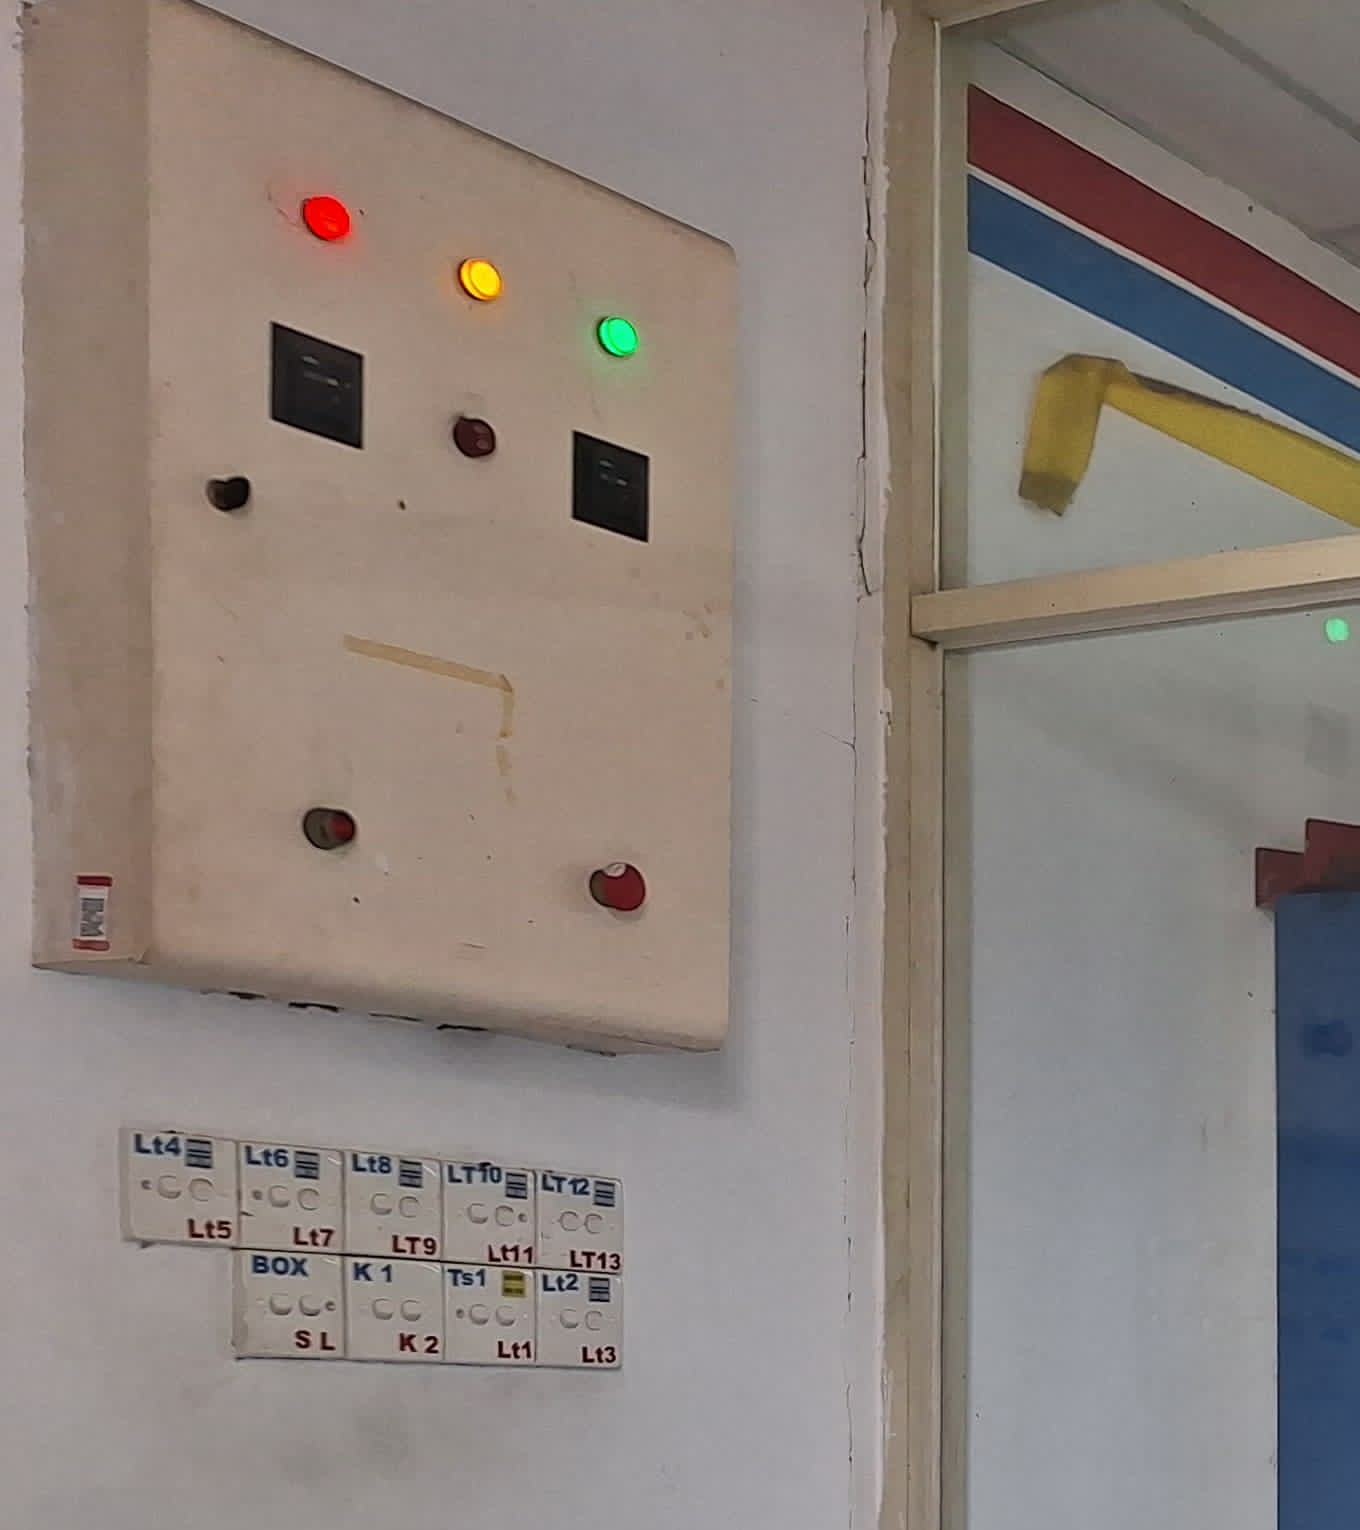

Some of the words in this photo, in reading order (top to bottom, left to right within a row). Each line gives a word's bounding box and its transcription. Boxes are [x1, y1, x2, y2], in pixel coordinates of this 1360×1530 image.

[134, 1133, 182, 1156] Lt4
[244, 1145, 290, 1168] Lt6
[351, 1153, 393, 1175] Lt8
[447, 1164, 503, 1184] LT10
[541, 1173, 591, 1196] LT12
[187, 1218, 232, 1240] Lt5
[293, 1227, 335, 1247] Lt7
[391, 1235, 437, 1256] LT9
[487, 1245, 534, 1264] Lt11
[251, 1255, 309, 1278] BOX
[569, 1250, 622, 1271] LT13
[447, 1268, 487, 1287] Ts1
[541, 1272, 580, 1293] Lt2
[497, 1340, 534, 1360] Lt1
[581, 1345, 617, 1365] Lt3
